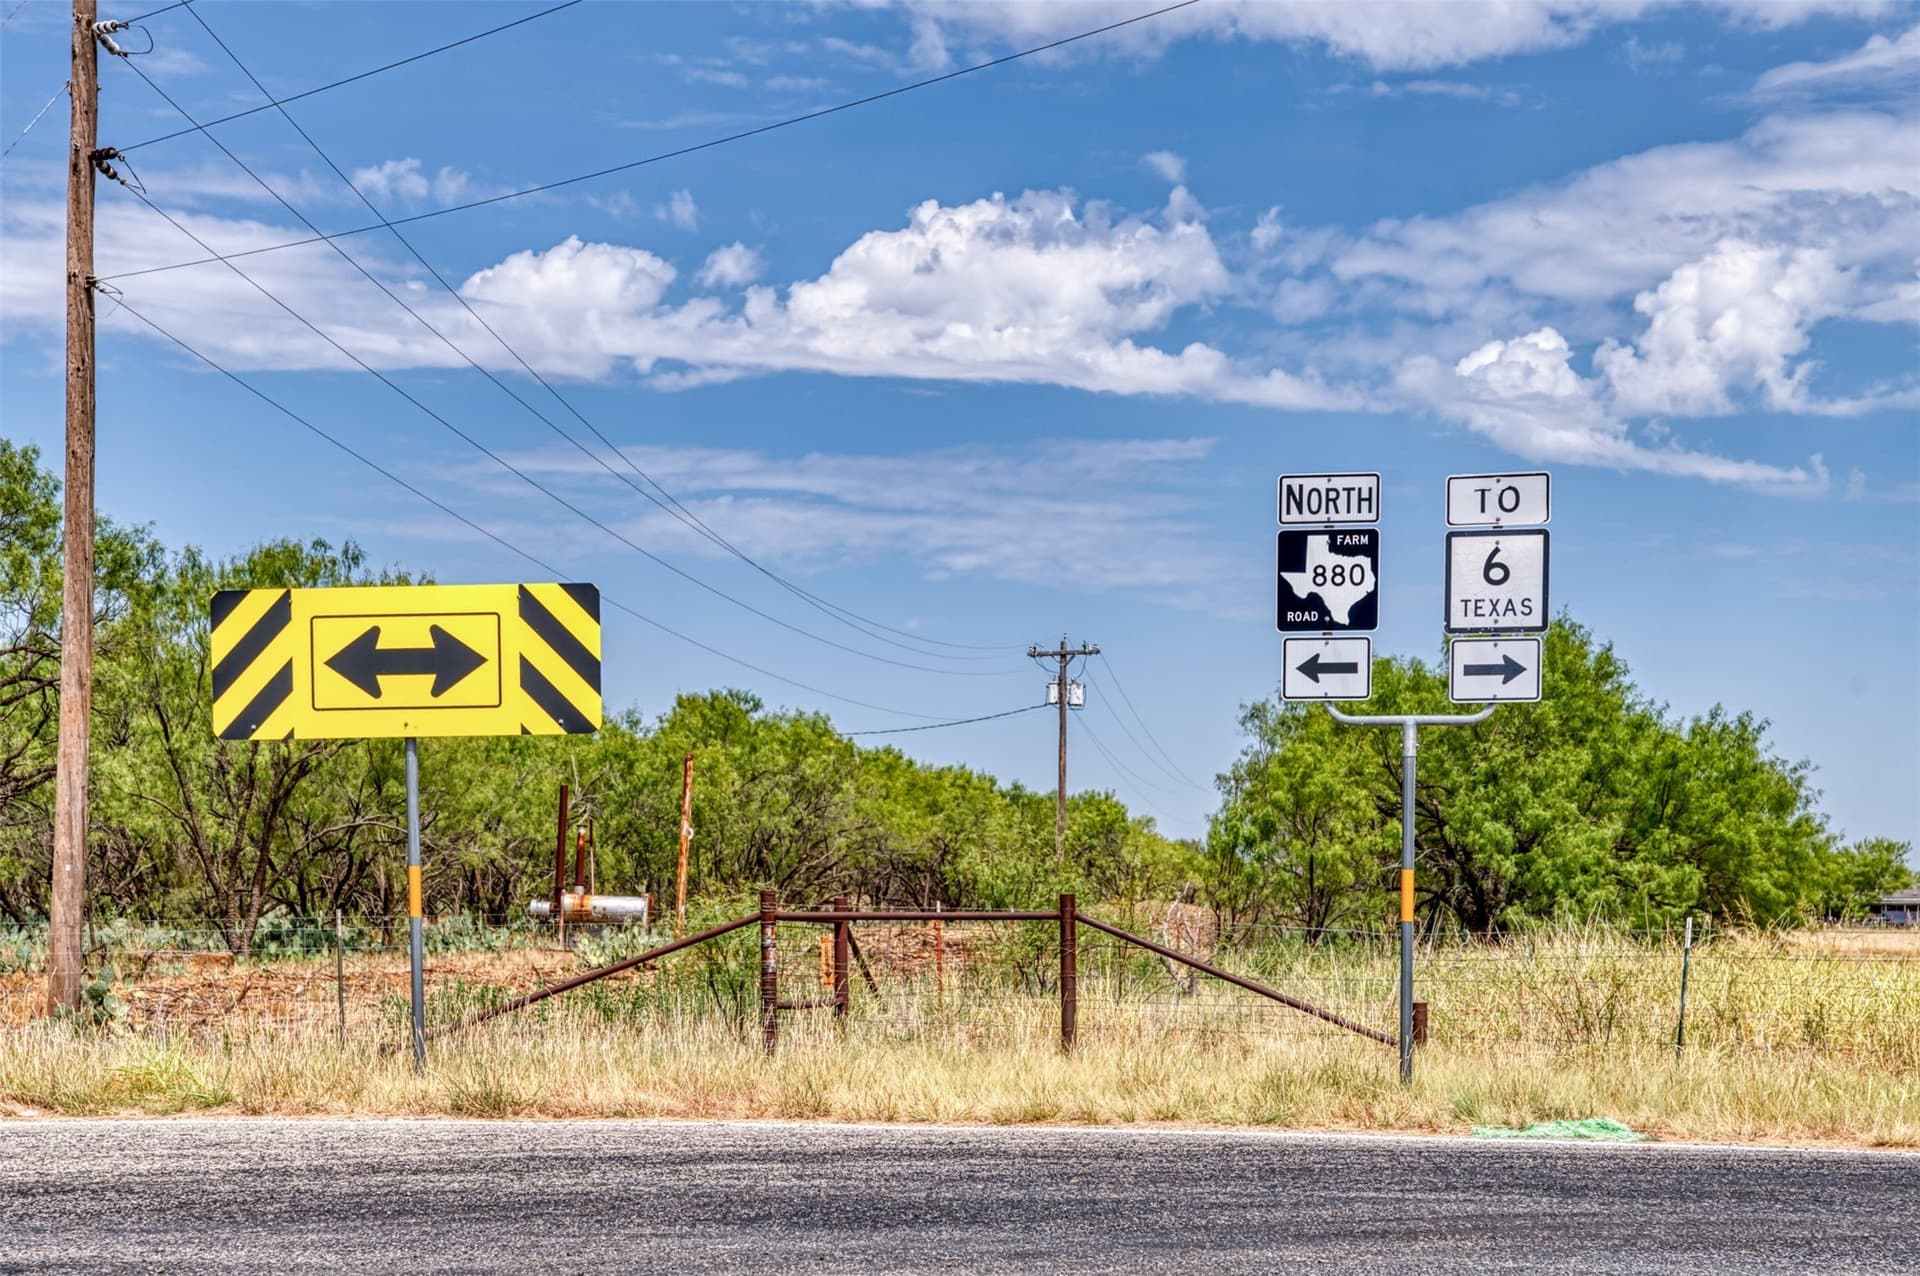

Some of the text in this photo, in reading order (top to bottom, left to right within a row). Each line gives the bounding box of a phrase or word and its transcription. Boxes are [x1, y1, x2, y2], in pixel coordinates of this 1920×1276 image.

[1286, 484, 1373, 515] NORTH
[1474, 485, 1521, 513] TO
[1336, 535, 1369, 546] FARM
[1312, 564, 1365, 587] 880
[1483, 546, 1511, 586] 6
[1287, 611, 1319, 622] ROAD
[1460, 598, 1533, 617] TEXAS
